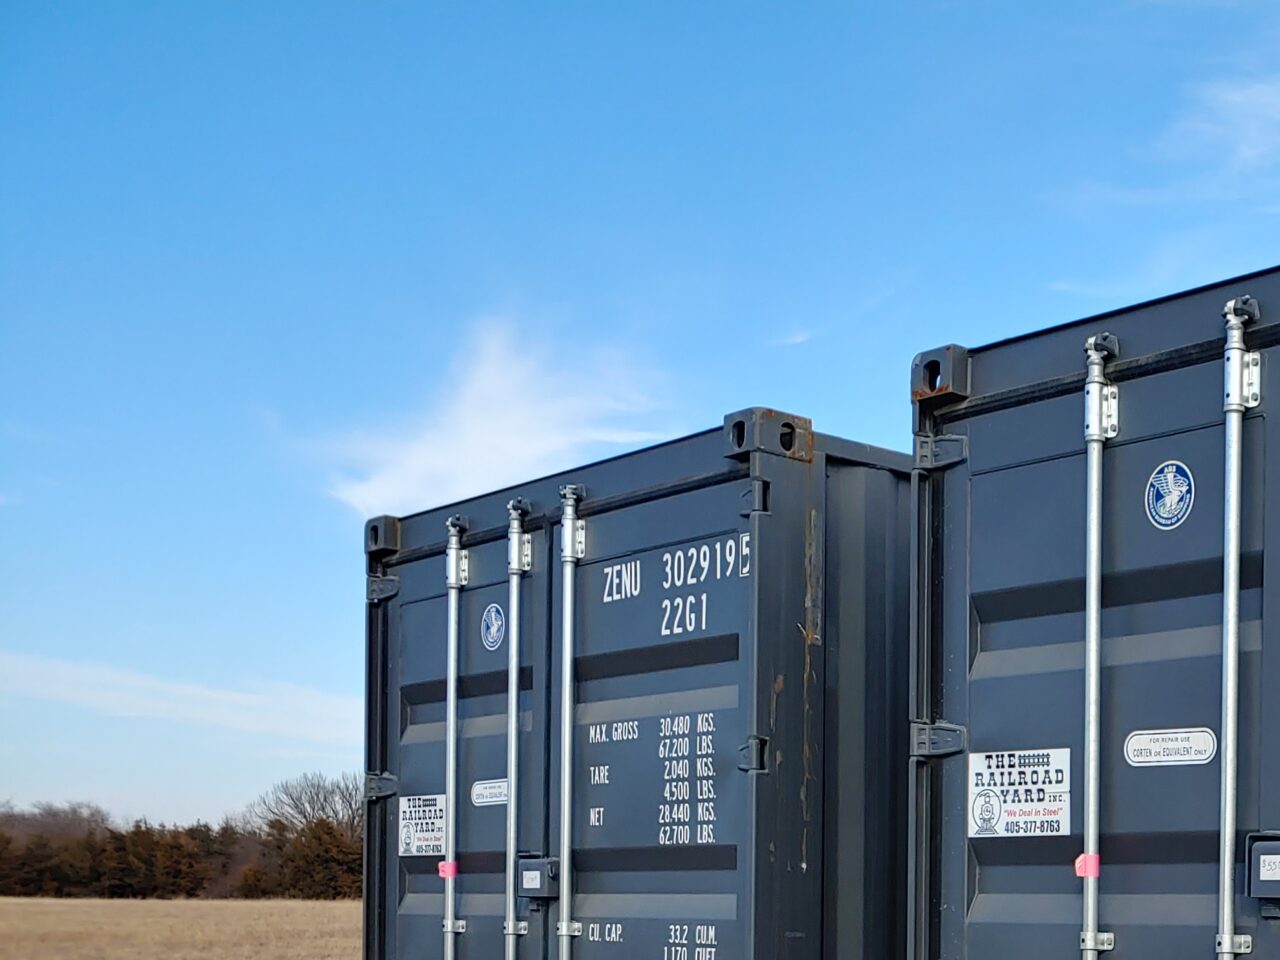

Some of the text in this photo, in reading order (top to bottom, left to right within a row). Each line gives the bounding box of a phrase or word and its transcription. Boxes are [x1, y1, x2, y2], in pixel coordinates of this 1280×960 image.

[603, 560, 641, 603] ZENU
[661, 592, 707, 636] 22G1
[589, 723, 609, 744] MAX.
[612, 720, 639, 741] GROSS
[697, 712, 716, 733] KGS.
[696, 735, 715, 755] LBS.
[1133, 748, 1152, 758] CORTEN
[1162, 746, 1193, 757] EQUIVALENT
[985, 753, 1016, 769] THE
[589, 765, 610, 785] TARE
[696, 757, 716, 777] KGS.
[975, 769, 1064, 787] RAILROAD
[697, 780, 717, 799] LBS.
[1000, 788, 1066, 804] YARD INC.
[407, 797, 421, 808] THE
[402, 808, 443, 821] RAILROAD
[589, 807, 604, 826] NET
[697, 802, 717, 822] KGS.
[1018, 808, 1033, 817] Deal
[414, 821, 435, 833] YARD
[697, 824, 716, 844] LBS.
[1004, 819, 1061, 833] 405-377-8763
[588, 923, 718, 945] CU. CAP. 33.2 CU.M.
